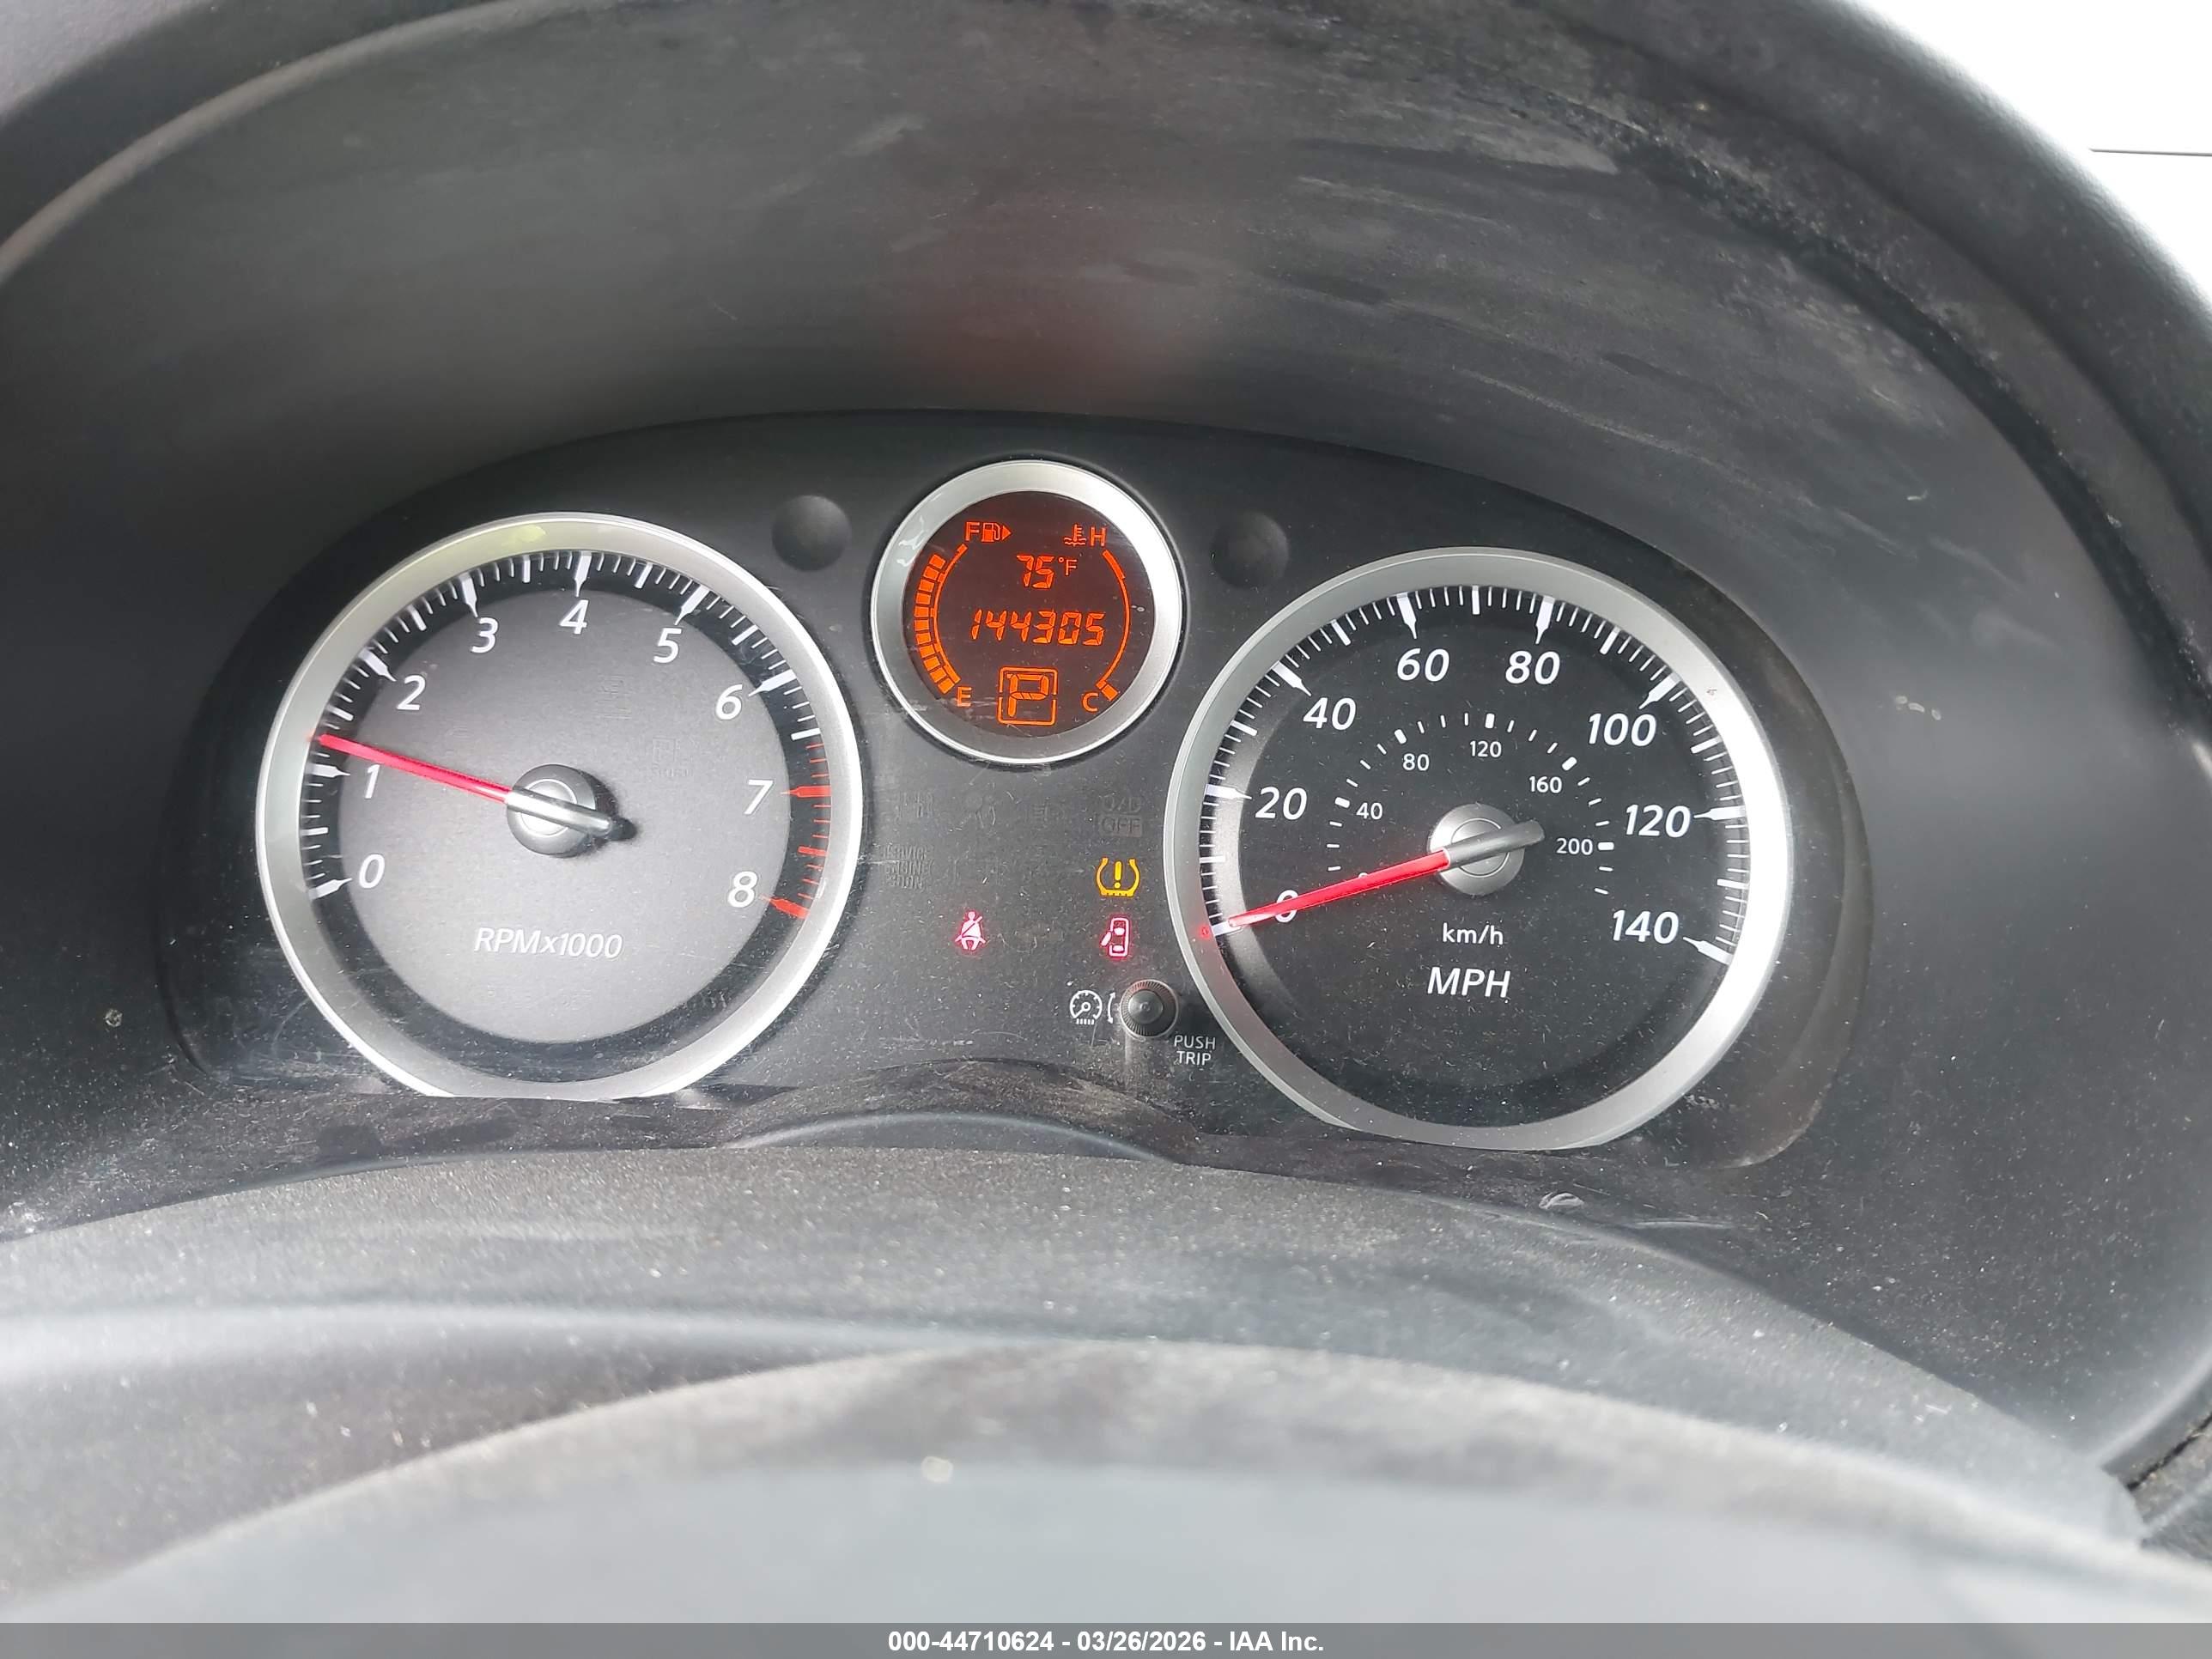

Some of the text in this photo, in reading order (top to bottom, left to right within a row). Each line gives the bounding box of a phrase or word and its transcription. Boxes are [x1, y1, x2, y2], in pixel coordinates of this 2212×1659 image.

[965, 522, 980, 541] F
[1090, 527, 1106, 547] H
[560, 599, 587, 635] 4
[971, 609, 1105, 646] 144305
[471, 617, 498, 653] 3
[653, 627, 682, 664] 5
[1397, 647, 1449, 682] 60
[1505, 651, 1560, 685] 80
[396, 675, 426, 711] 2
[715, 684, 743, 720] 6
[957, 686, 972, 708] E
[1008, 673, 1049, 718] P
[1082, 692, 1099, 712] C
[1303, 697, 1356, 731] 40
[1589, 713, 1656, 747] 100
[1402, 753, 1430, 771] 80
[1469, 740, 1502, 758] 120
[364, 763, 380, 799] 1
[744, 779, 774, 815] 7
[1528, 775, 1563, 793] 160
[1255, 786, 1308, 820] 20
[1356, 802, 1383, 820] 40
[1626, 804, 1691, 838] 120
[1556, 837, 1594, 855] 200
[358, 854, 386, 889] 0
[727, 871, 758, 908] 8
[473, 927, 623, 958] RPMx1000
[1443, 922, 1504, 945] km/h
[1613, 909, 1680, 945] 140
[1427, 966, 1511, 998] MPH
[1174, 1035, 1216, 1050] PUSH
[1176, 1051, 1212, 1066] TRIP
